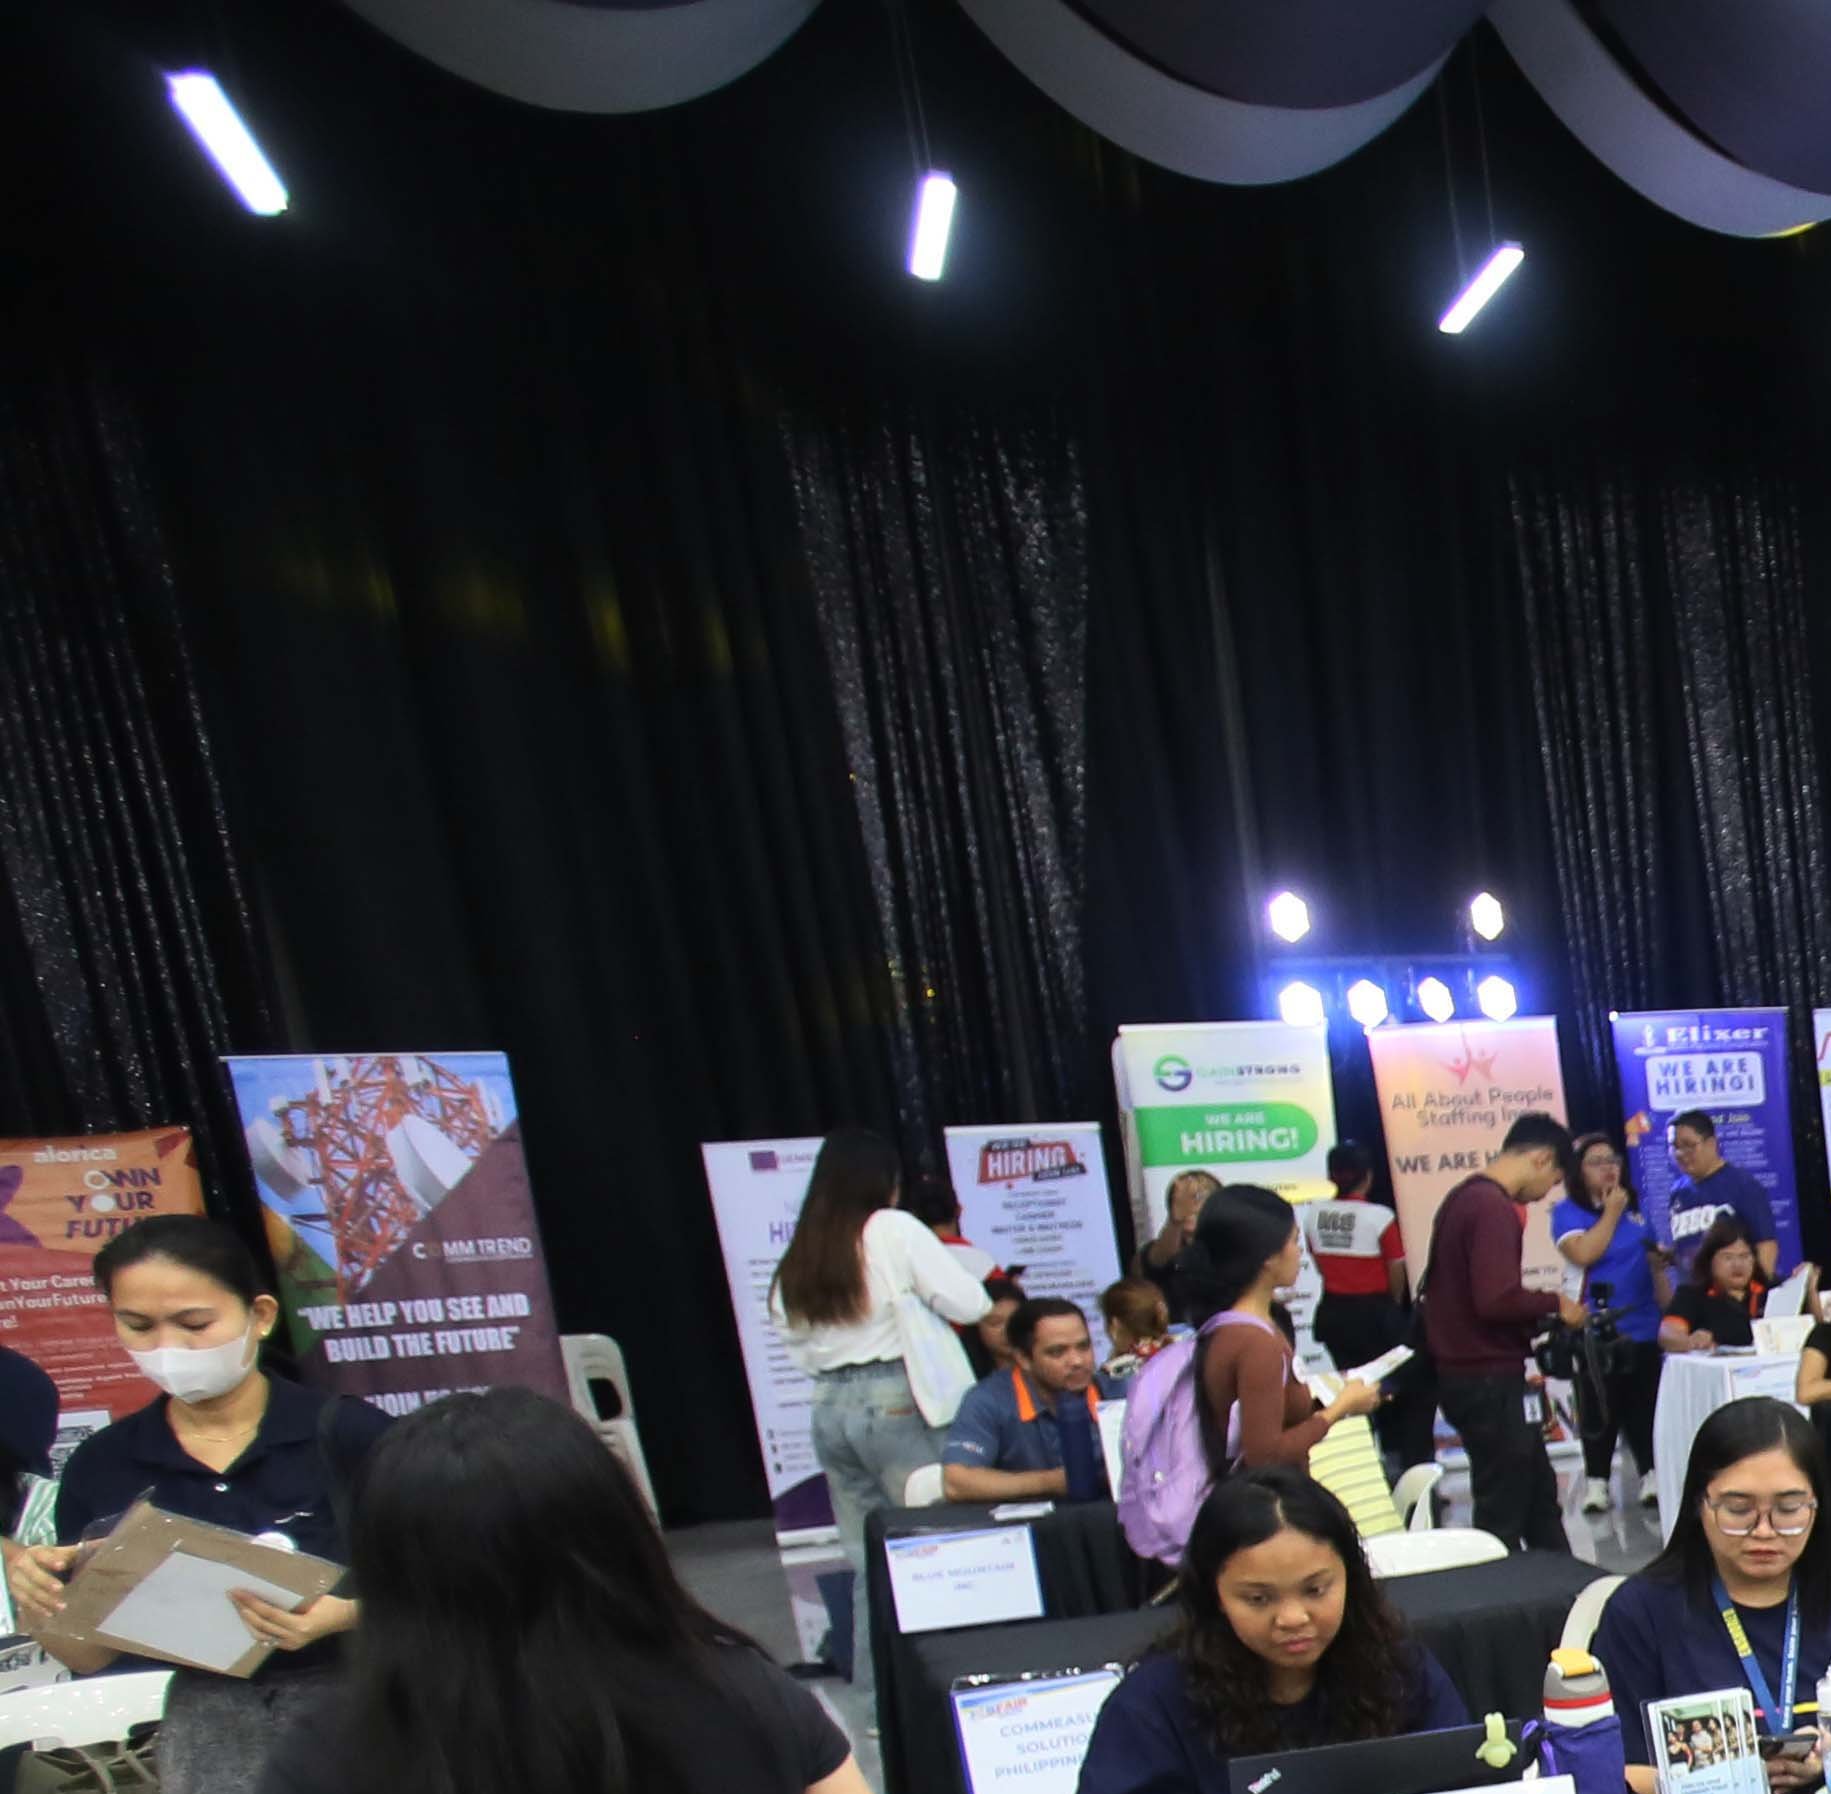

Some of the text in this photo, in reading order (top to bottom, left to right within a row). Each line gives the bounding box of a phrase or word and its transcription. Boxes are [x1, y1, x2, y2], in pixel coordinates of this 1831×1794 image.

[1665, 1024, 1769, 1043] Elixer
[1658, 1057, 1749, 1077] WE ARE
[1391, 1085, 1555, 1110] All About People
[1204, 1111, 1266, 1126] WE ARE
[1415, 1107, 1497, 1129] Staffing
[1179, 1126, 1299, 1156] HIRING!
[33, 1145, 118, 1164] alorica
[1395, 1150, 1482, 1175] WE ARE
[83, 1168, 162, 1190] OWN
[478, 1237, 535, 1256] TREND
[345, 1293, 533, 1329] HELP YOU SEE AND
[323, 1335, 392, 1364] BUILD
[391, 1331, 436, 1359] THE
